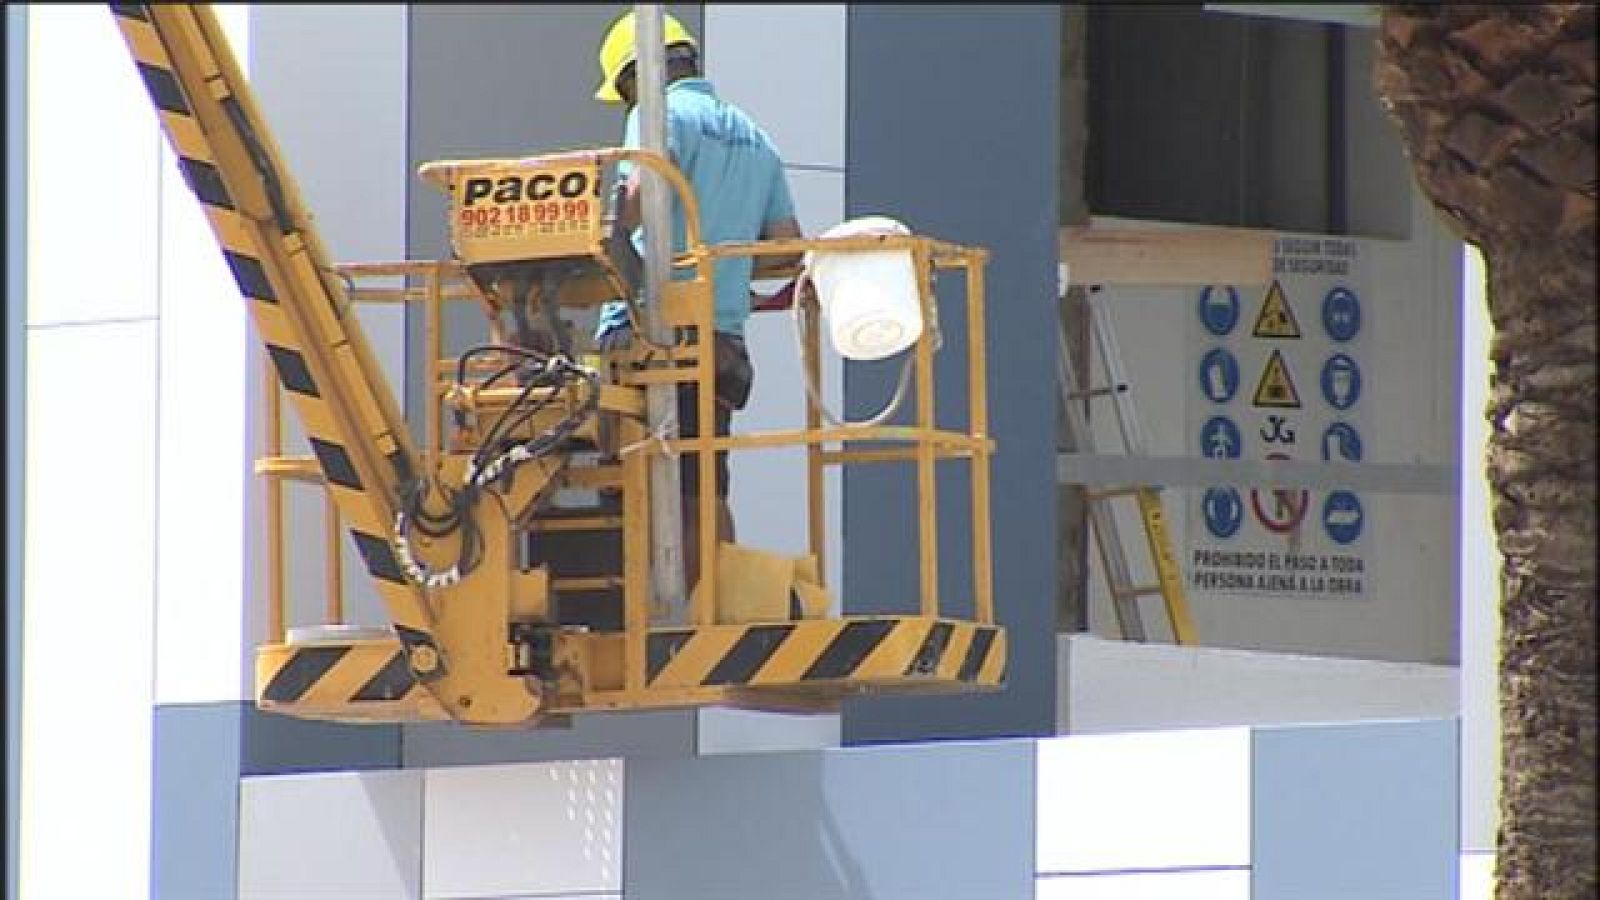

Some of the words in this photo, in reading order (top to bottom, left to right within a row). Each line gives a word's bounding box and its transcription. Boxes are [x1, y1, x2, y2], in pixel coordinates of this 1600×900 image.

[461, 208, 500, 227] 902
[507, 205, 530, 223] 18
[1194, 549, 1266, 569] PROHIBIDO
[1269, 552, 1280, 570] EL
[1285, 553, 1318, 571] PASO
[1320, 555, 1328, 571] A
[1332, 555, 1364, 573] TODA
[1194, 571, 1253, 590] PERSONA
[1257, 574, 1296, 591] AJENA
[1309, 577, 1324, 592] LA
[1329, 577, 1361, 594] OBRA
